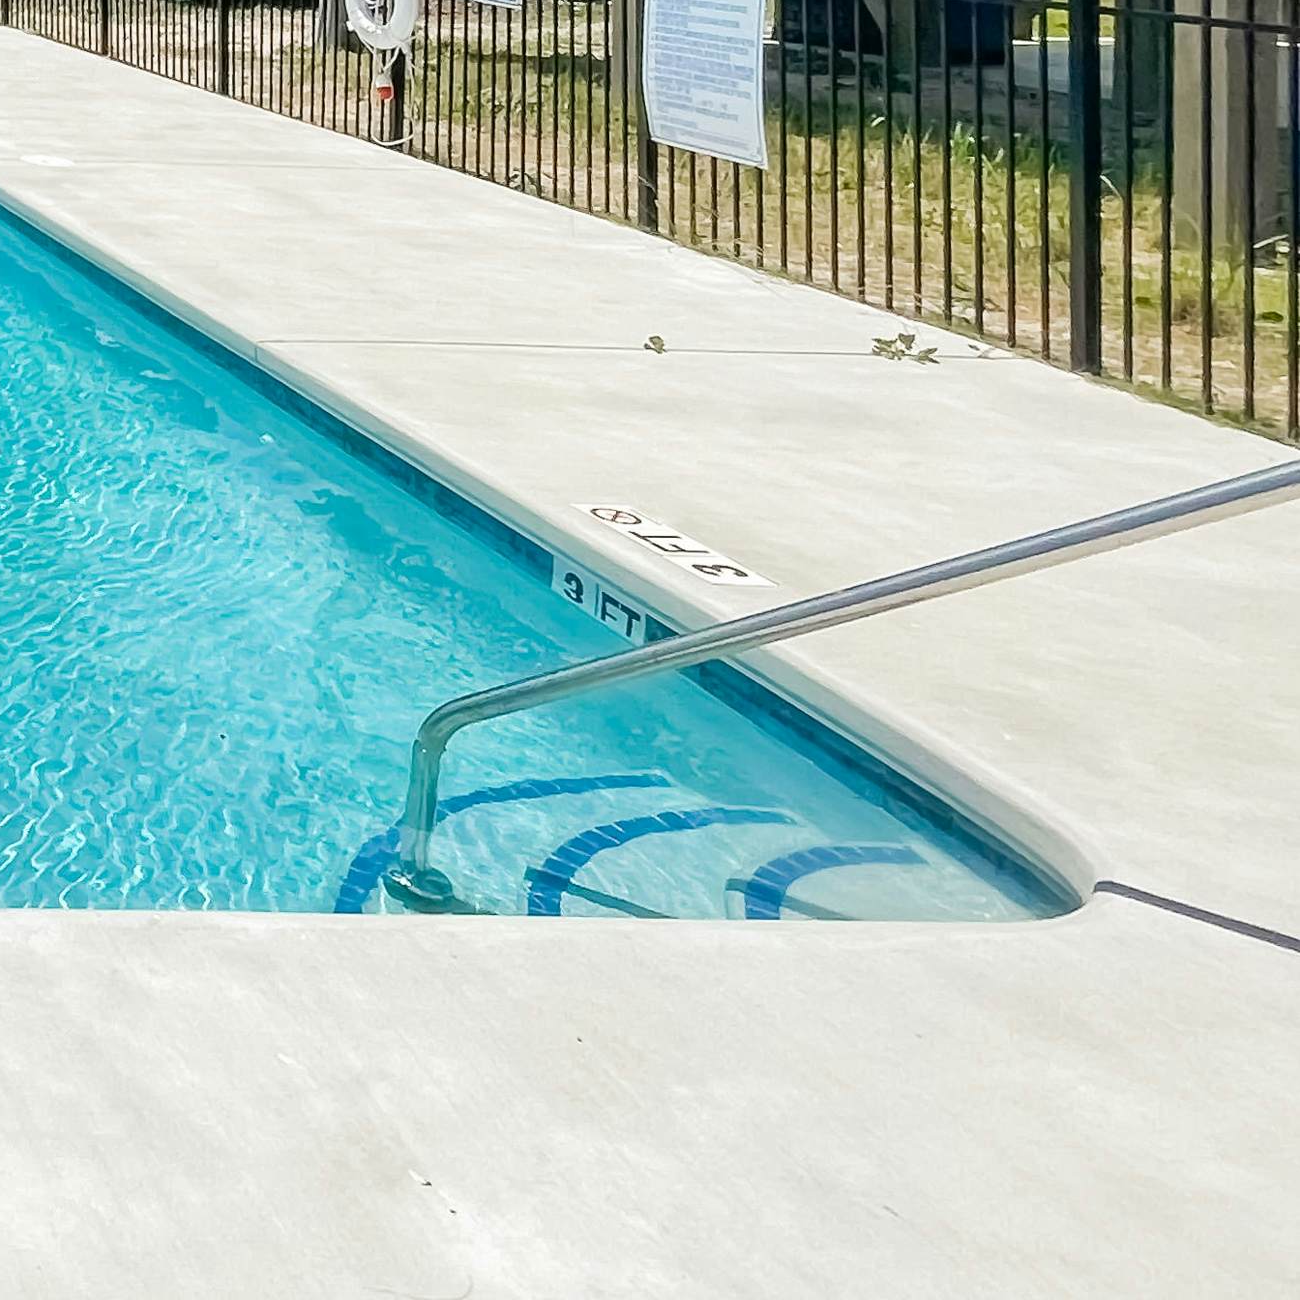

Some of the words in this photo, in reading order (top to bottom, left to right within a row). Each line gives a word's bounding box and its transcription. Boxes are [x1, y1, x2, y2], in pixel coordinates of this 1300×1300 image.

[629, 531, 710, 555] FT
[691, 563, 748, 578] 3
[563, 572, 584, 604] 3
[600, 590, 641, 637] FT
